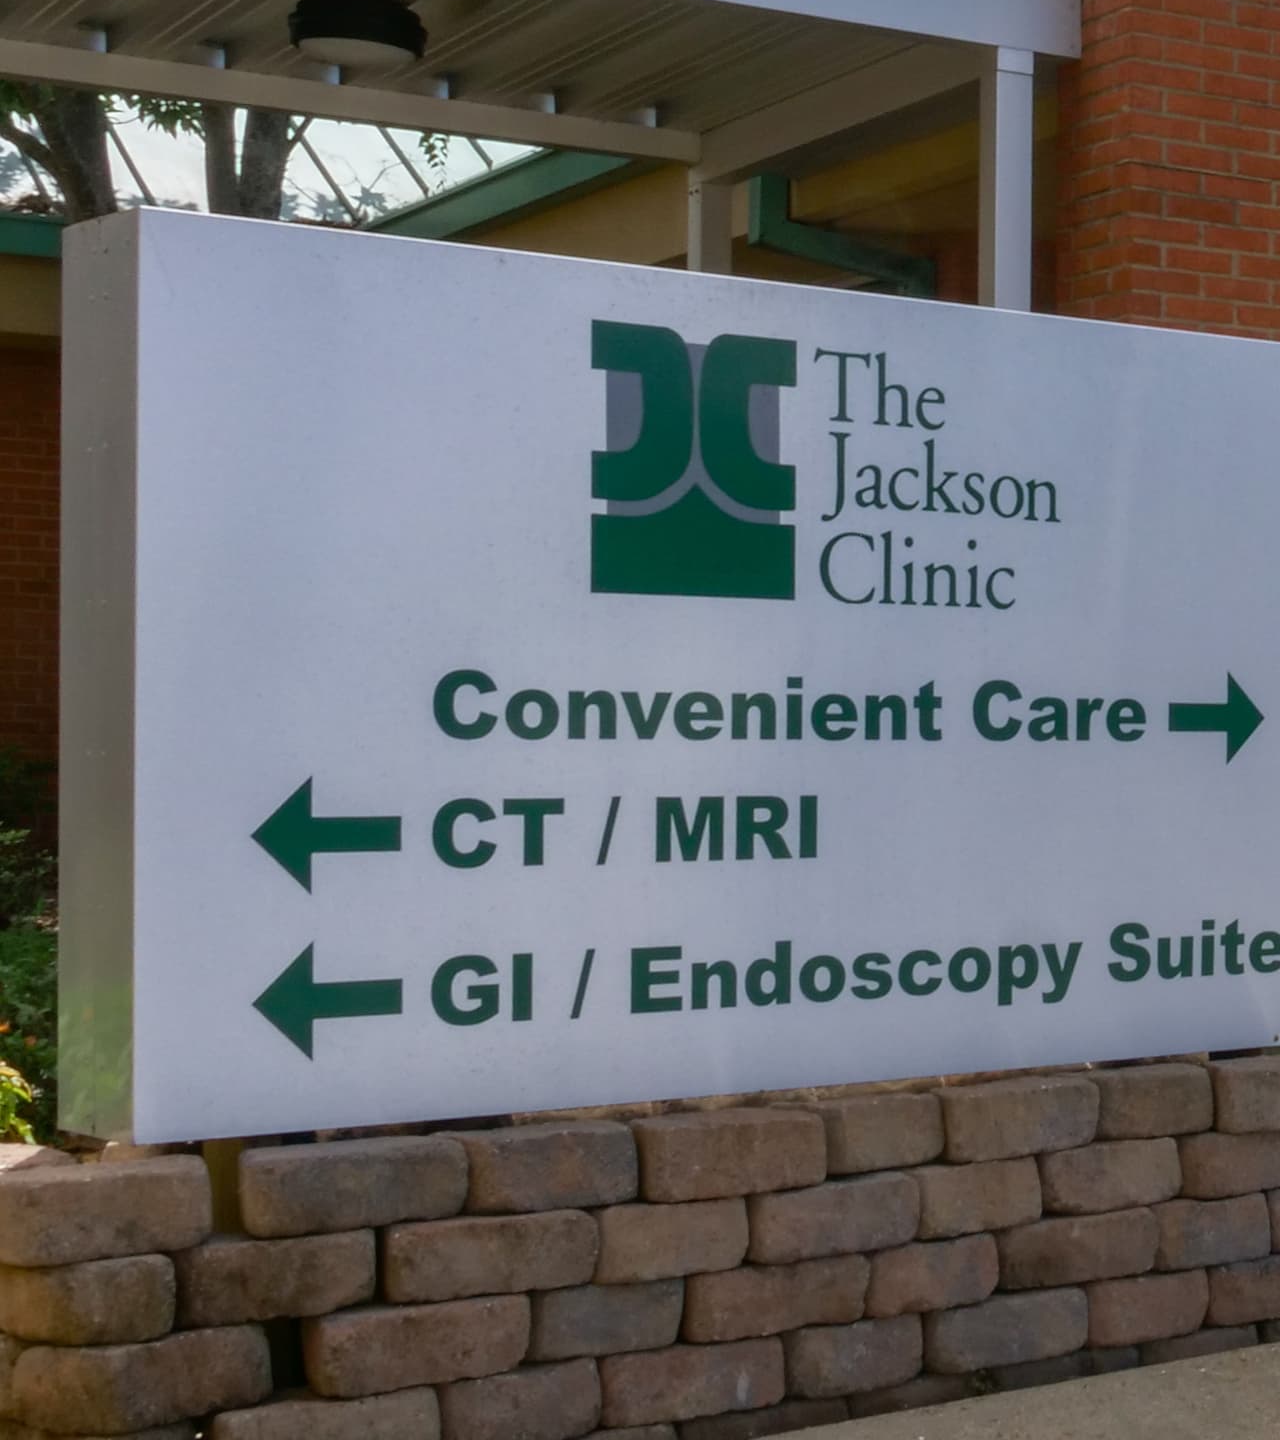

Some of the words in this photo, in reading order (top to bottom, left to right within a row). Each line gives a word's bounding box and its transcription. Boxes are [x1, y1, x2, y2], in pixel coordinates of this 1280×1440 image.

[813, 346, 947, 432] The
[820, 430, 1062, 523] Jackson
[818, 530, 1017, 610] Clinic
[431, 668, 944, 742] Convenient
[972, 679, 1148, 743] Care
[431, 796, 566, 870] CT
[595, 795, 621, 867] /
[653, 794, 820, 864] MRI
[429, 954, 534, 1027] GI
[569, 948, 596, 1020] /
[628, 939, 1084, 1016] Endoscopy
